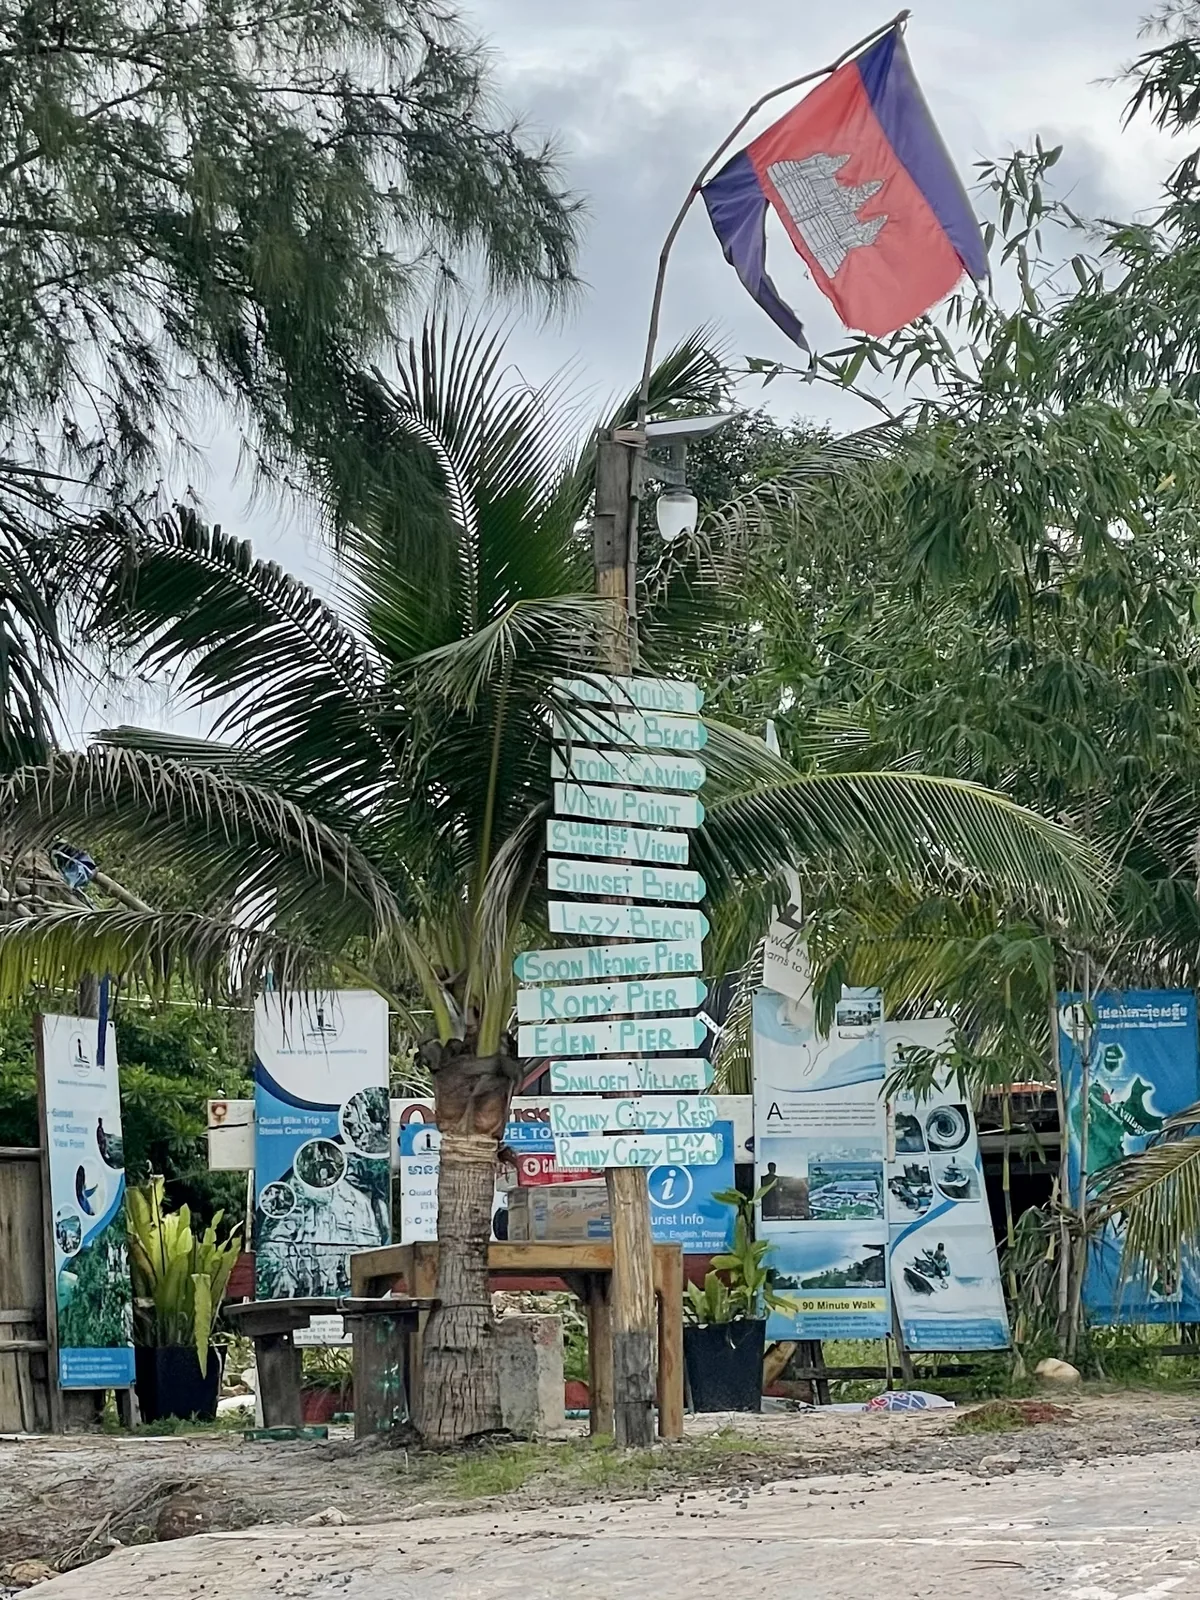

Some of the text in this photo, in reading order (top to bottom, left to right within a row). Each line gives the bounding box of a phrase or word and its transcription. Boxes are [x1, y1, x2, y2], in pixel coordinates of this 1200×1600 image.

[560, 757, 618, 782] TONE
[555, 861, 700, 901] SUNSET BEACH
[561, 903, 696, 939] LAZY BEACH
[524, 953, 583, 980] SOON
[791, 962, 803, 973] to
[539, 987, 619, 1020] ROMY
[551, 1062, 630, 1091] SANLOEM
[259, 1117, 281, 1125] Quad
[303, 1117, 320, 1126] Trip
[615, 1101, 673, 1128] COZY
[504, 1127, 527, 1139] PEL
[613, 1137, 663, 1165] COZY
[651, 1213, 704, 1225] urist Info
[802, 1300, 876, 1310] 90 Minute Walk
